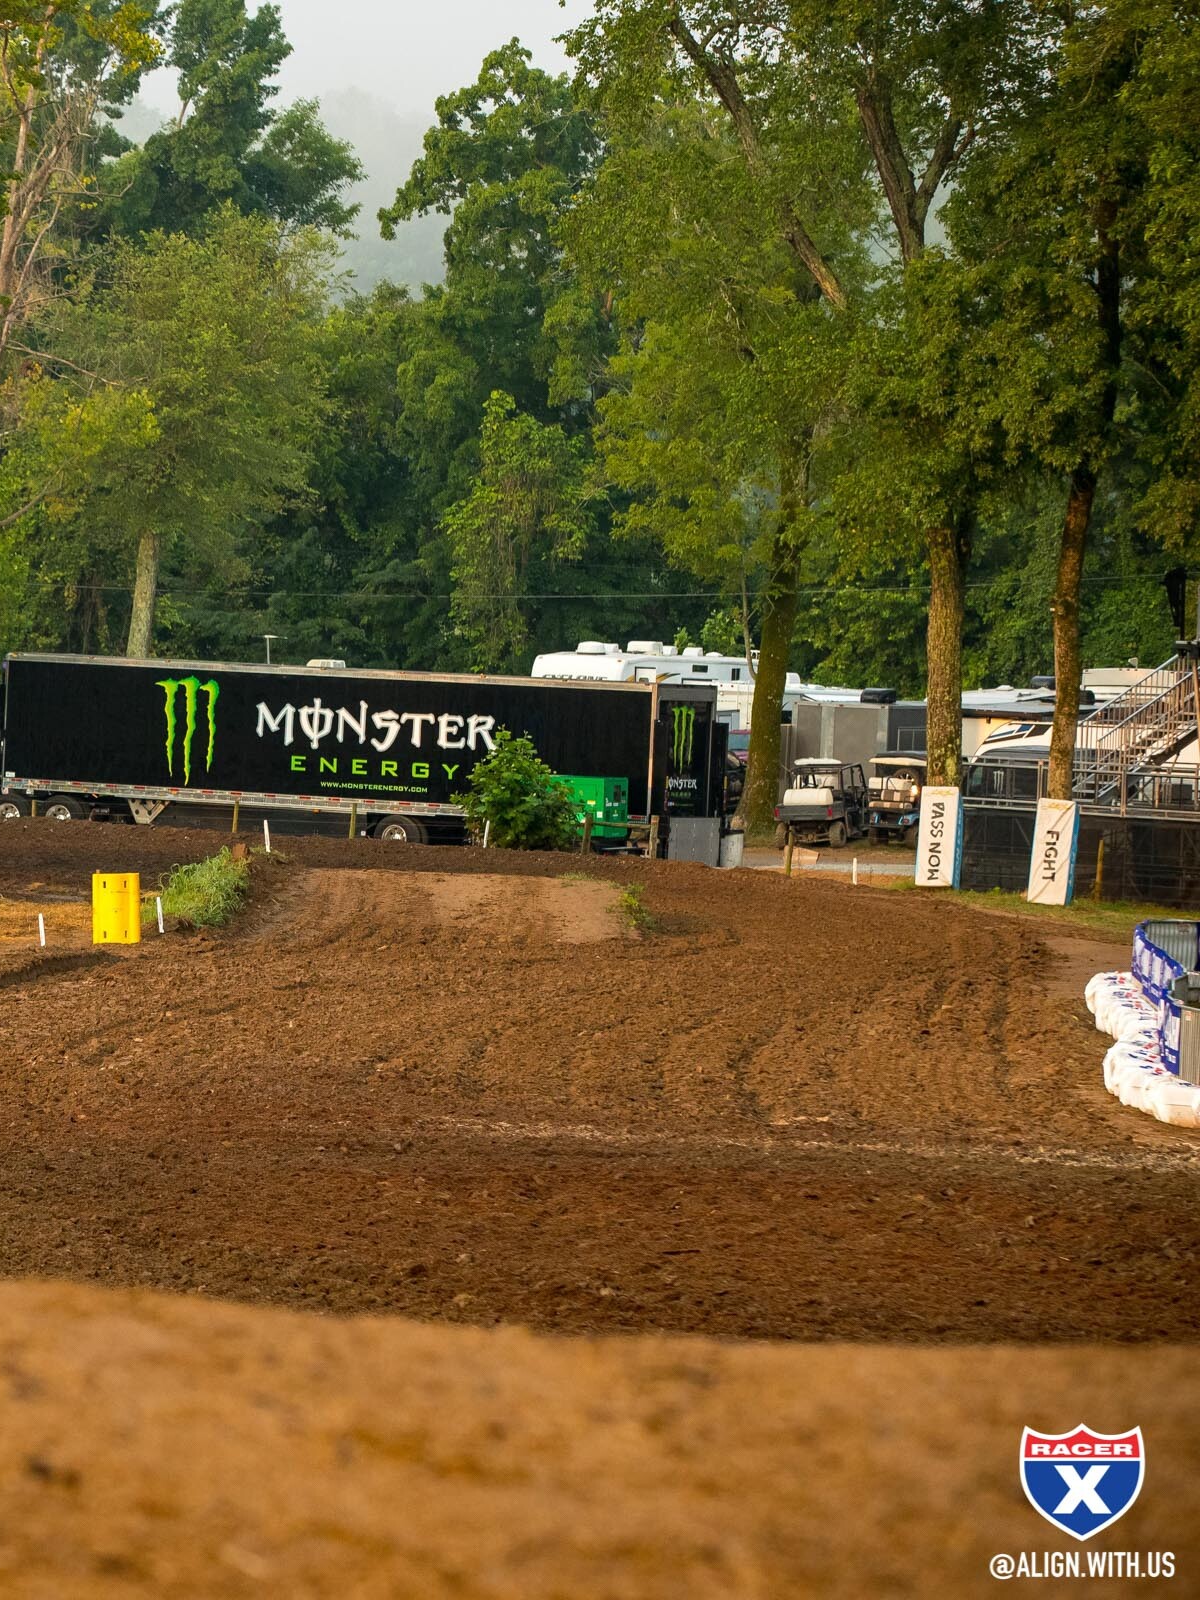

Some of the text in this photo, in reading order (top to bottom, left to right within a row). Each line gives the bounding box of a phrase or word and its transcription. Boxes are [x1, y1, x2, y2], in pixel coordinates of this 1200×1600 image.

[256, 698, 497, 752] MONSTER
[290, 755, 460, 780] ENERGY
[666, 776, 698, 790] ONSTER
[320, 781, 428, 793] WWW.MONSTERENERGY.COM
[930, 802, 945, 838] PASS
[927, 842, 942, 881] NOW
[1042, 829, 1060, 882] FIGHT
